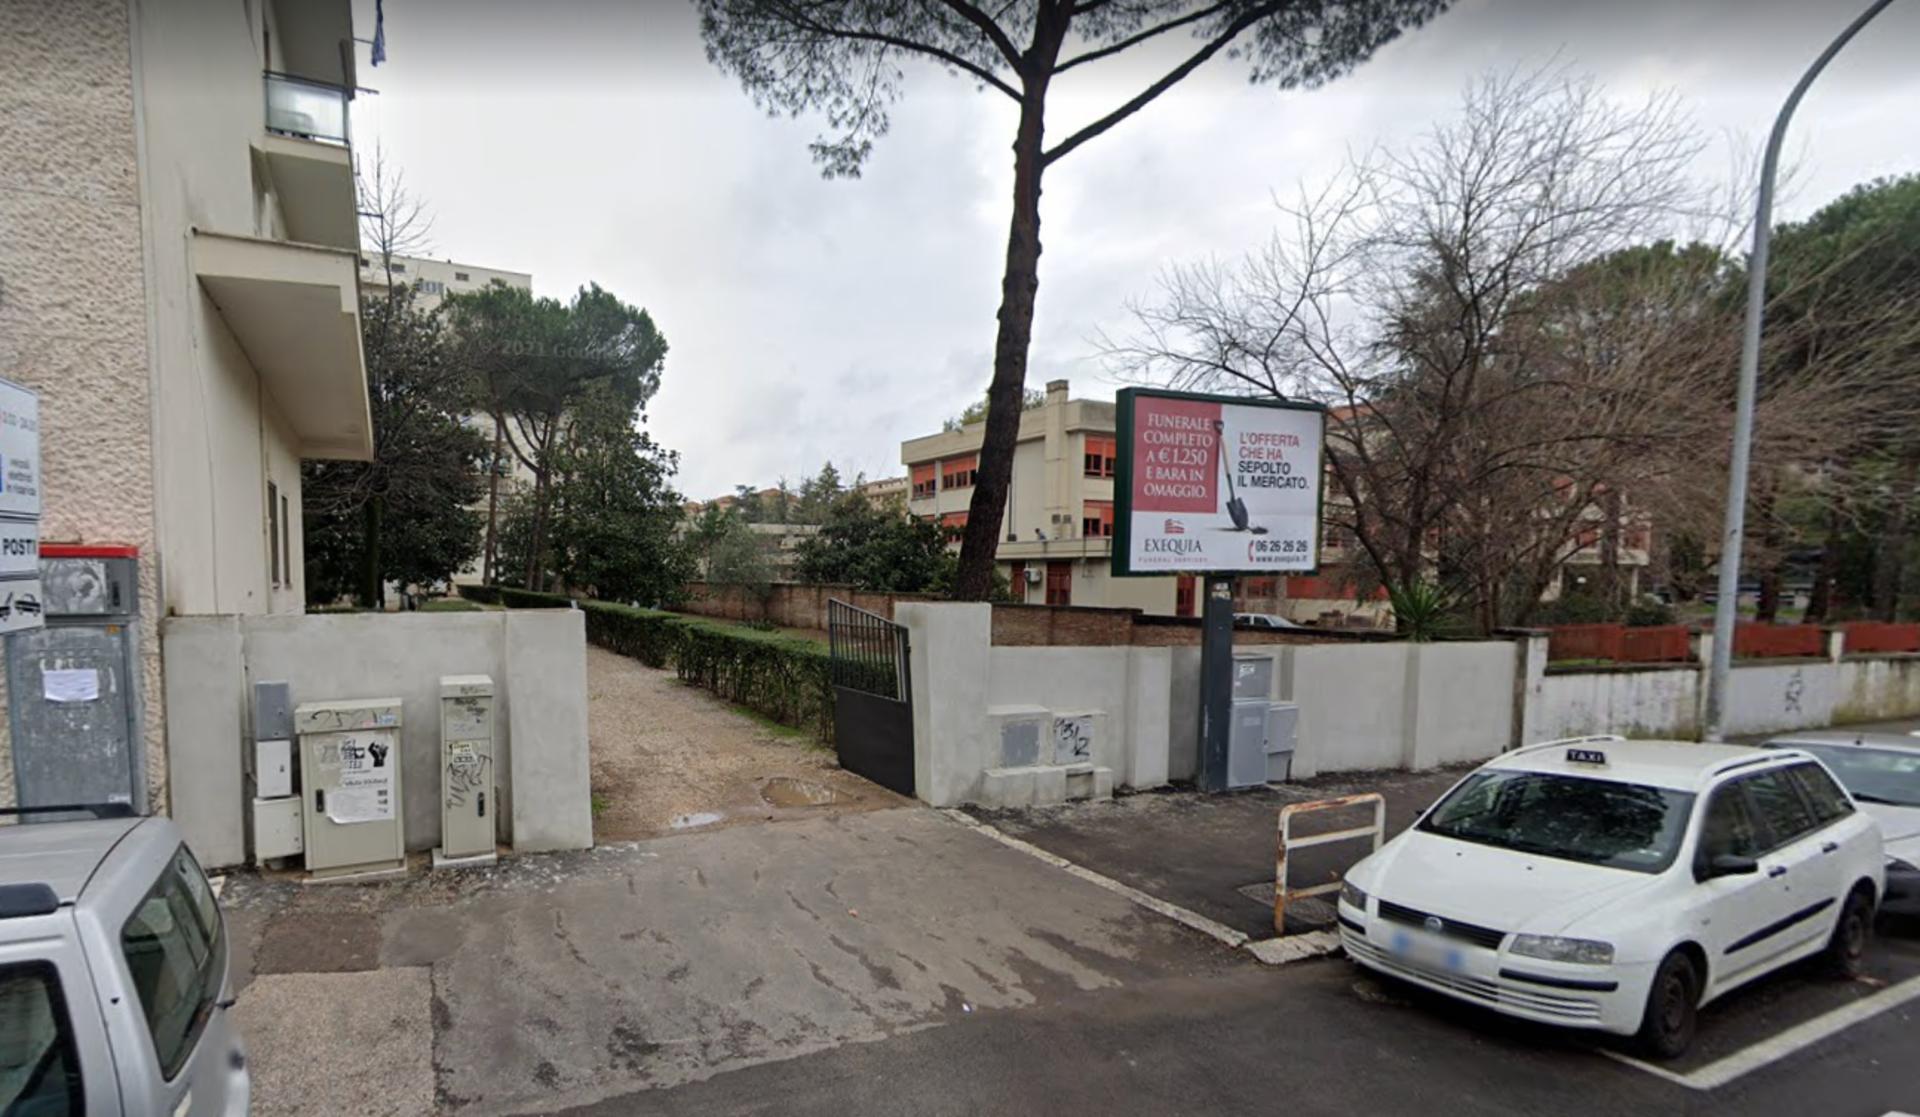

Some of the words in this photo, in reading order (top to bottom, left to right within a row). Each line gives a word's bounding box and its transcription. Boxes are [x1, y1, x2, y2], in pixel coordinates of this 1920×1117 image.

[1148, 413, 1211, 430] FUNERALE
[1143, 430, 1214, 447] COMPLETO
[1239, 432, 1300, 448] L'OFFERTA
[1146, 450, 1155, 463] A
[1159, 447, 1170, 464] €
[1239, 446, 1264, 459] CHE
[1267, 447, 1283, 461] HA
[1146, 466, 1153, 480] E
[1156, 467, 1187, 481] BARA
[1190, 468, 1204, 481] IN
[1238, 460, 1291, 475] SEPOLTO
[1237, 475, 1247, 488] IL
[1250, 475, 1310, 490] MERCATO.
[1143, 482, 1208, 499] OMAGGIO.
[1144, 538, 1203, 556] EXEQUIA
[1255, 540, 1268, 552] 06
[1270, 540, 1281, 552] 26
[1283, 540, 1294, 552] 26
[1296, 540, 1308, 553] 26
[1570, 751, 1601, 761] TAXI
